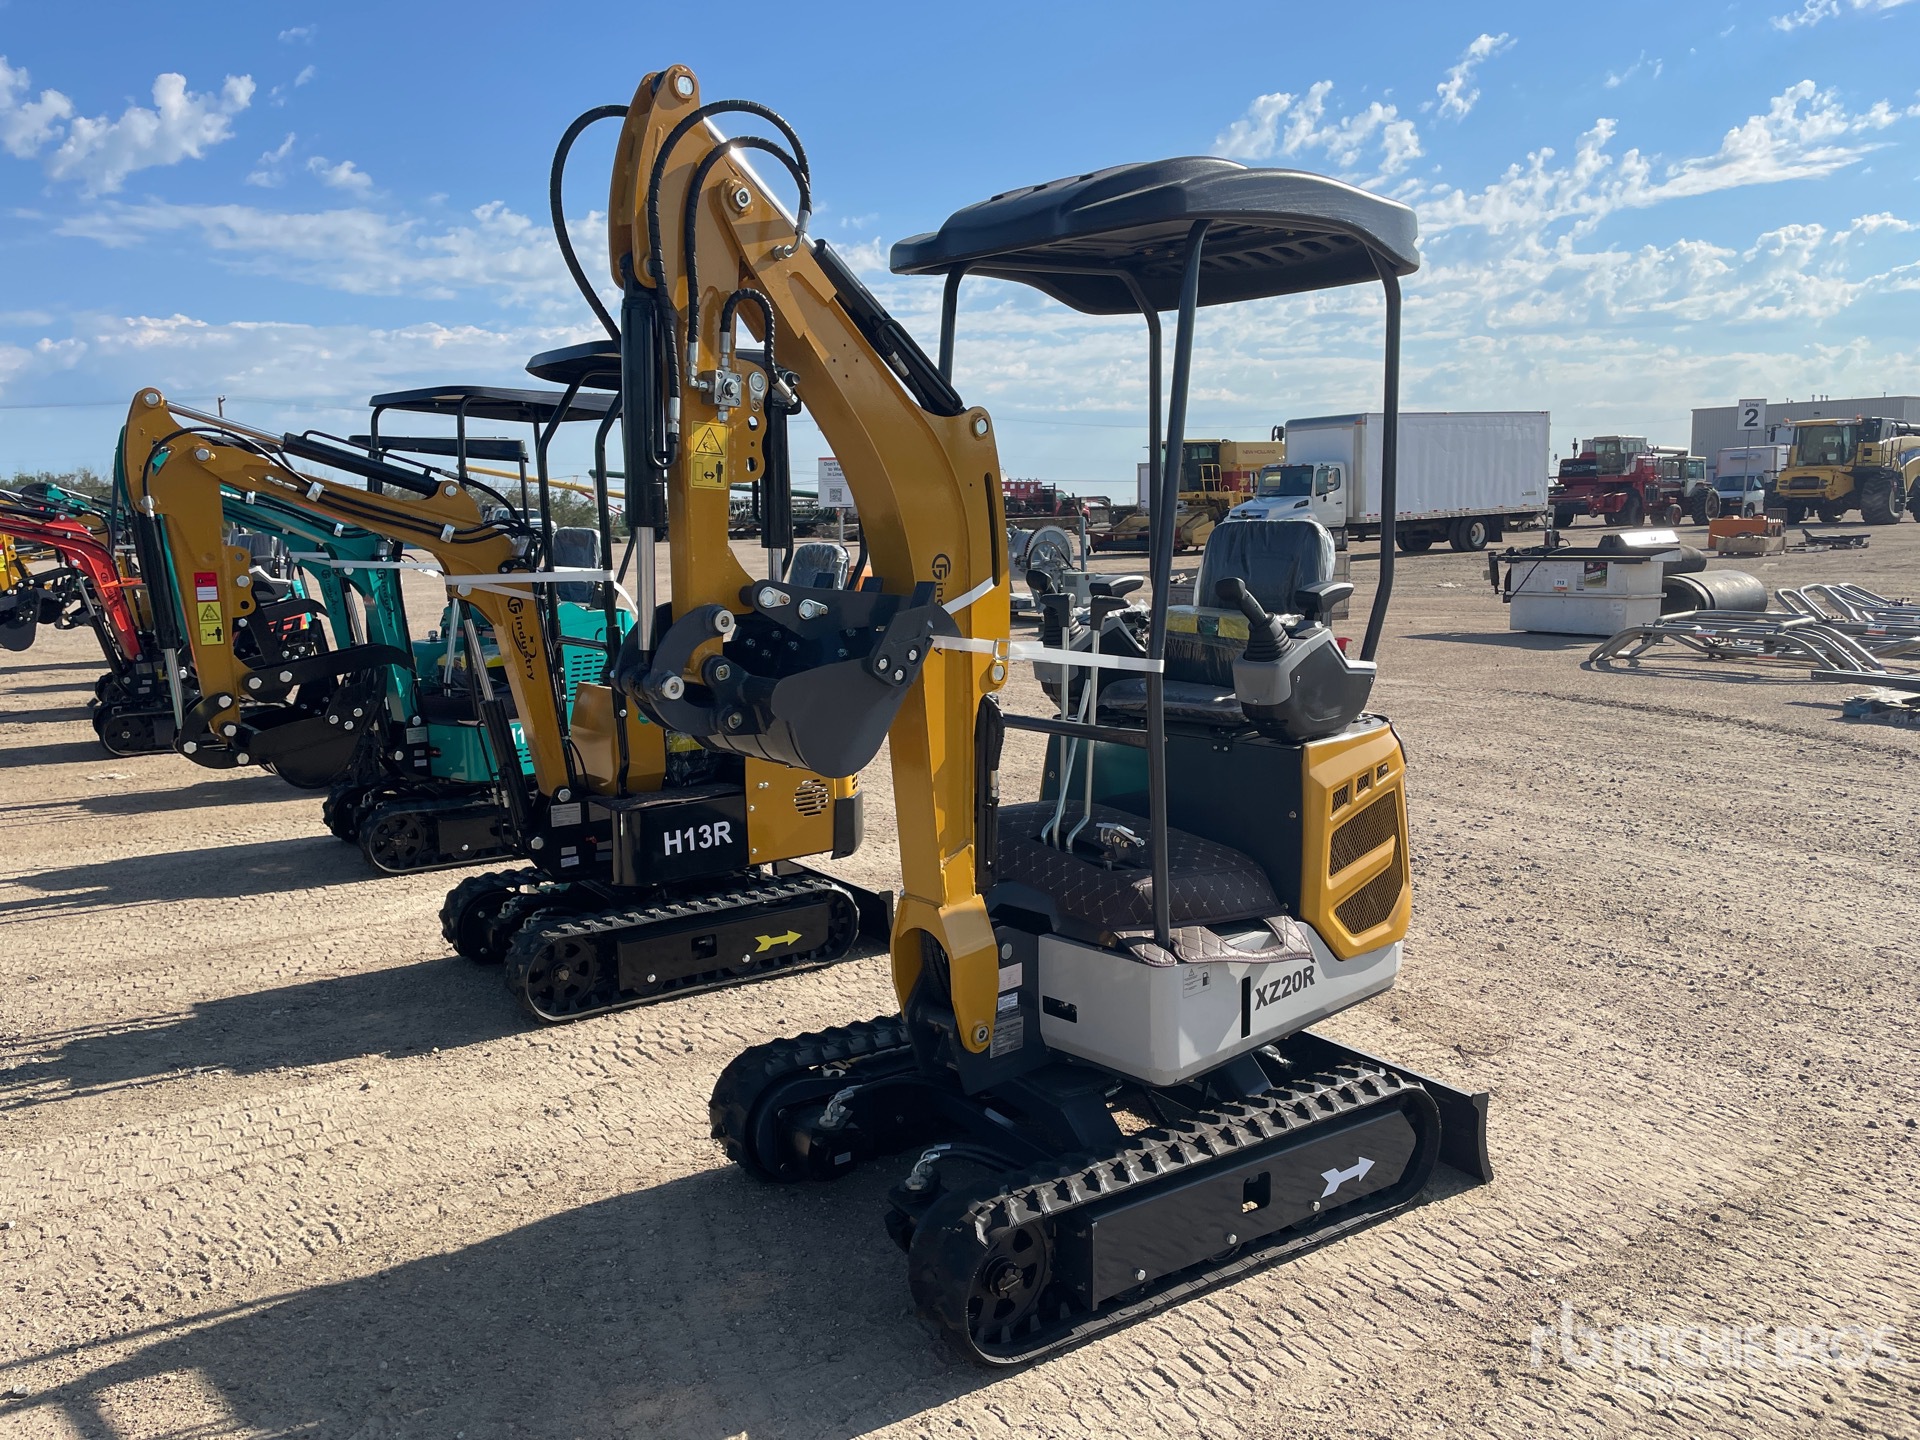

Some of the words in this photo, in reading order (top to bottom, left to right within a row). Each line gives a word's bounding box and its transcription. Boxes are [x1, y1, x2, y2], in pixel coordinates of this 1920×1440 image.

[1743, 408, 1759, 427] 2
[515, 616, 535, 681] industry
[663, 820, 733, 856] H13R
[1254, 965, 1316, 1011] XZ20R
